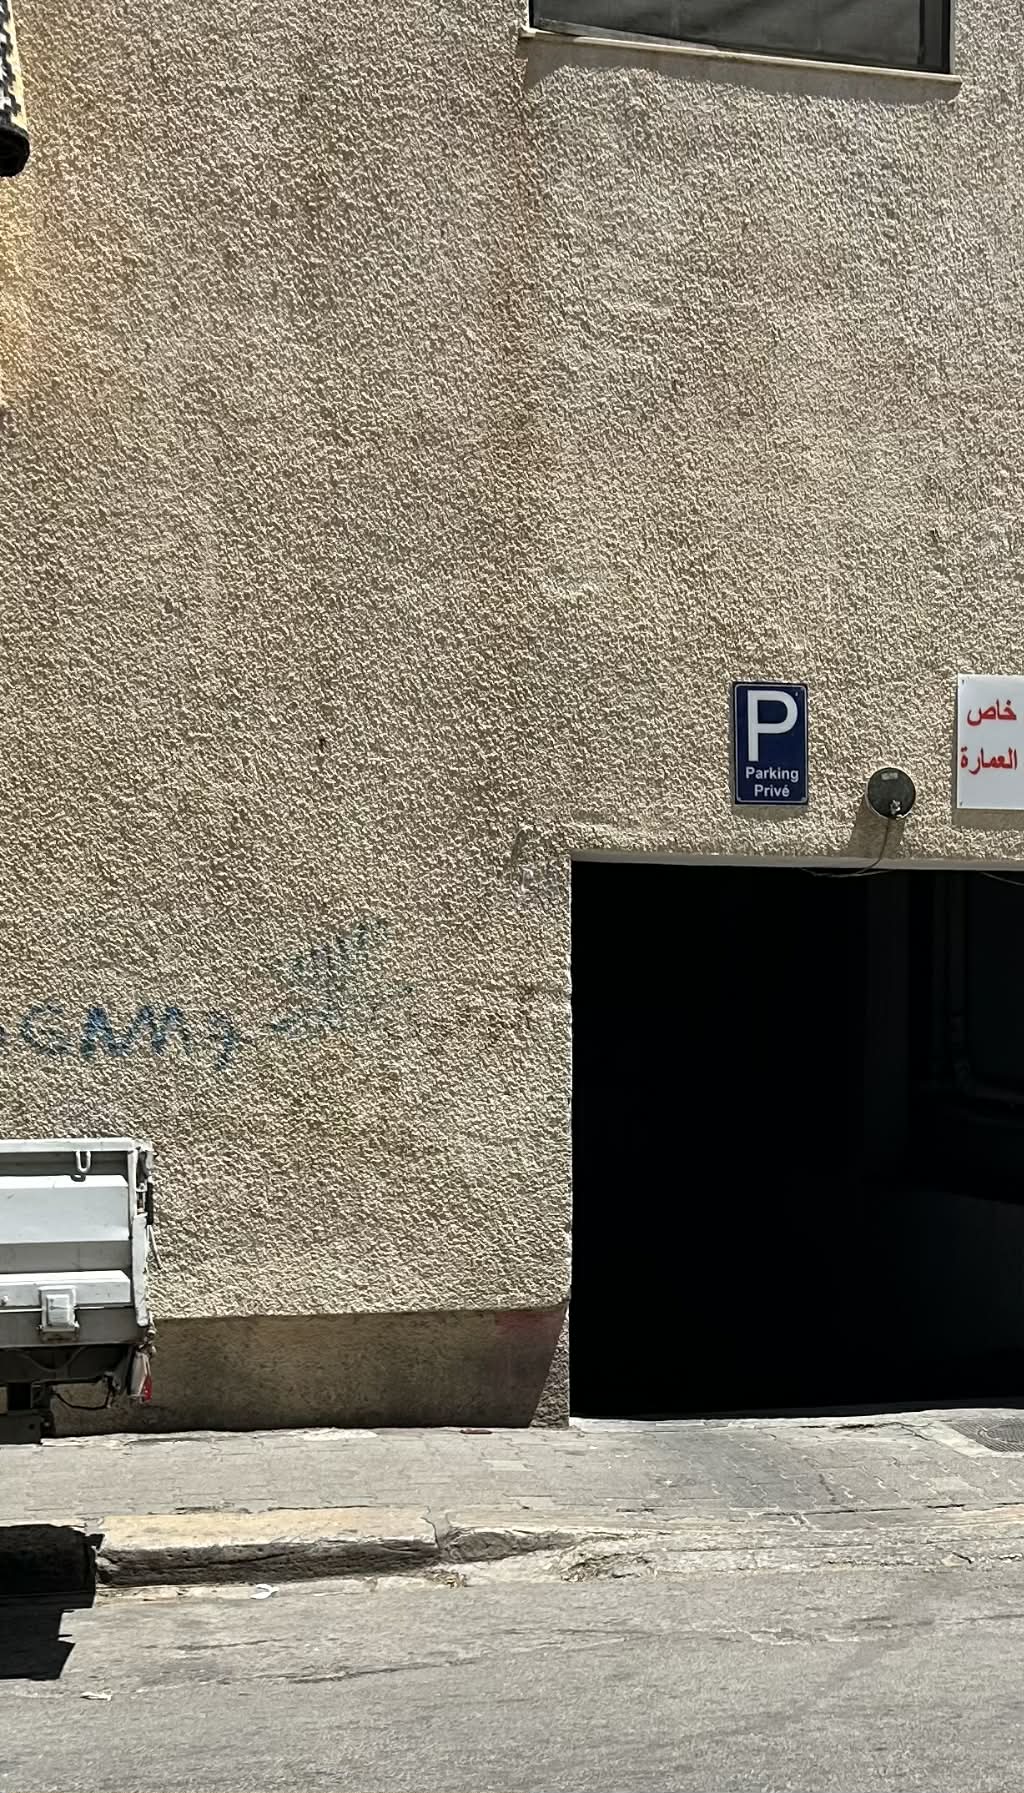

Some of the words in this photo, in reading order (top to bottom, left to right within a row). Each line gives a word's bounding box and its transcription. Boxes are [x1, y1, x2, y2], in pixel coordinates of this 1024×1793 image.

[747, 690, 798, 761] P
[967, 699, 1017, 726] خاص
[960, 746, 1017, 775] العمارة
[745, 767, 799, 782] Parking
[754, 785, 790, 797] Privé
